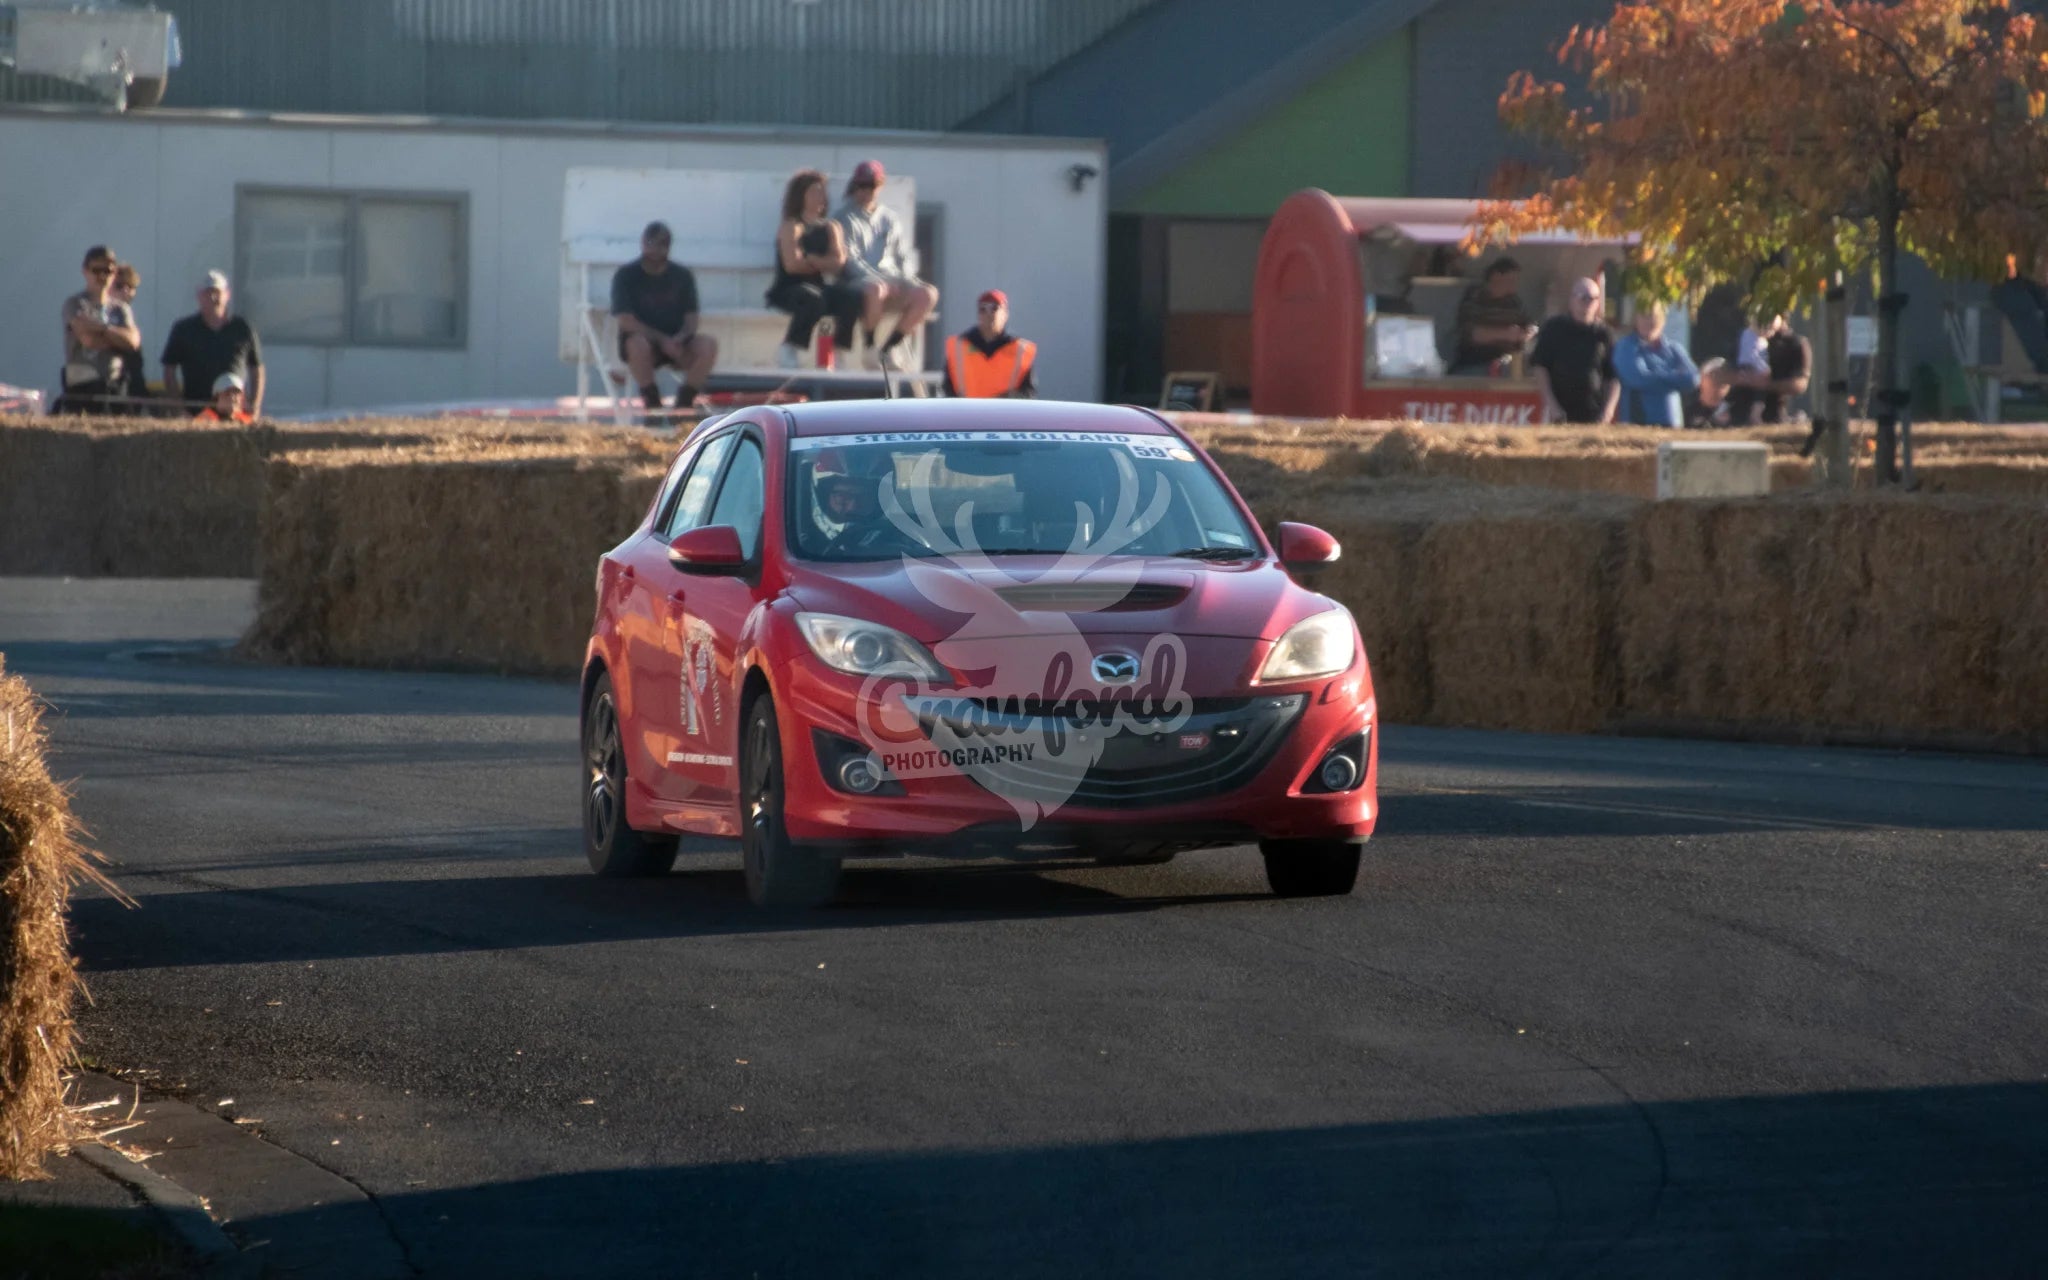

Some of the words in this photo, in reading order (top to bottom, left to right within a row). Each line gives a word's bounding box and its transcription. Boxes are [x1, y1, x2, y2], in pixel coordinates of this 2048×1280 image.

[1405, 402, 1456, 422] THE
[854, 432, 973, 443] STEWART
[985, 432, 1000, 440] &
[1009, 432, 1131, 443] HOLLAND
[1181, 737, 1202, 746] TOW
